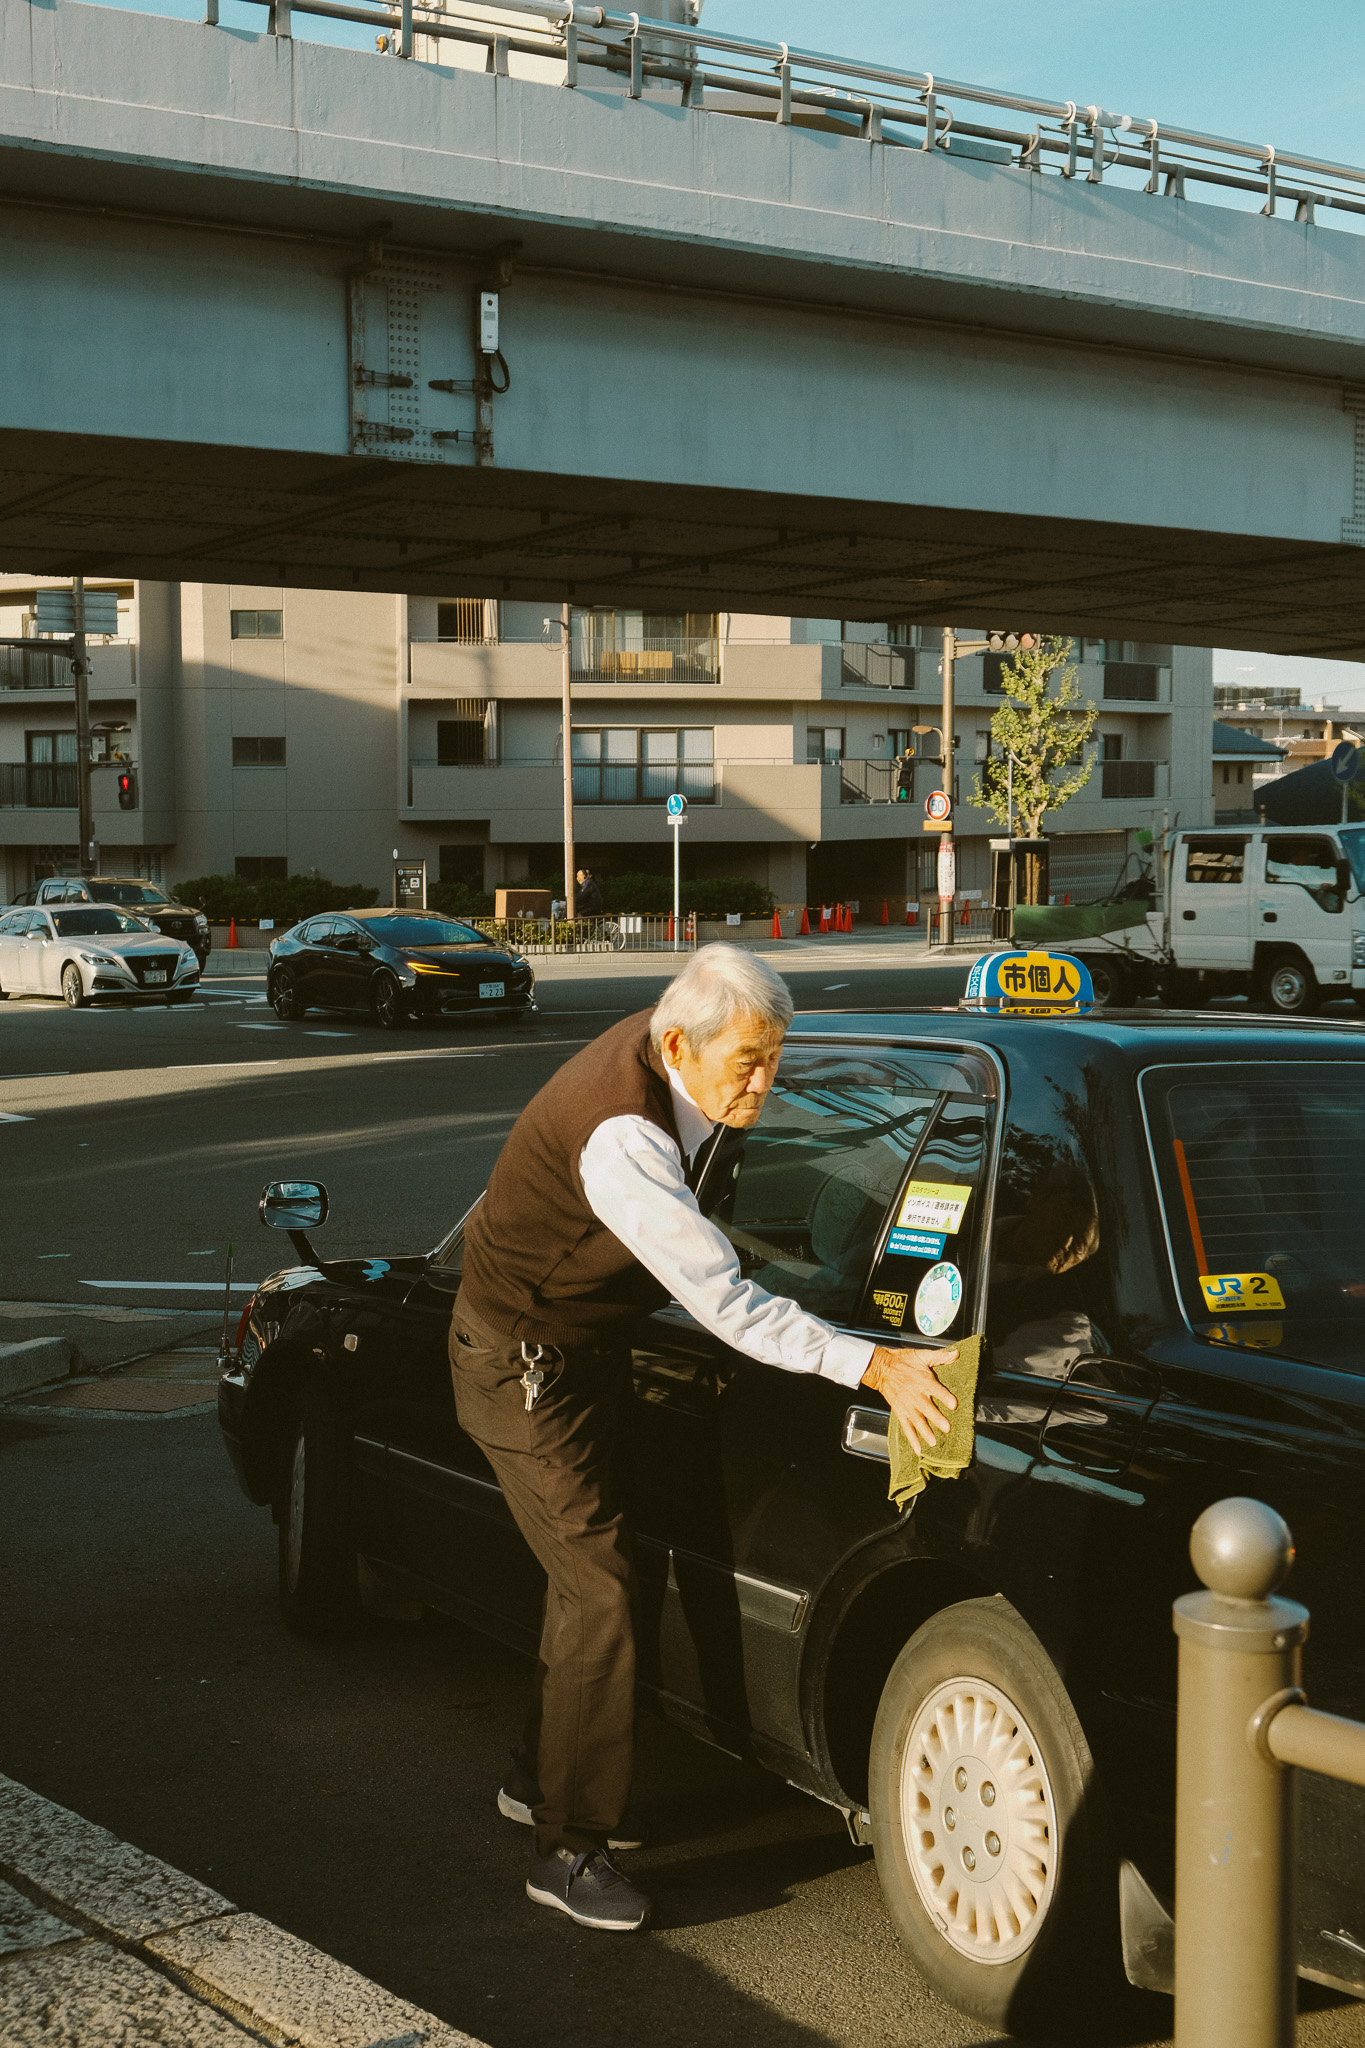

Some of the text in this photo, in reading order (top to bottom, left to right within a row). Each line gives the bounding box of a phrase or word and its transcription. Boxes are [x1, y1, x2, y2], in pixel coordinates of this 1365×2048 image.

[930, 798, 944, 812] 50
[1003, 963, 1075, 994] 市個人
[1206, 1277, 1269, 1296] JR 2
